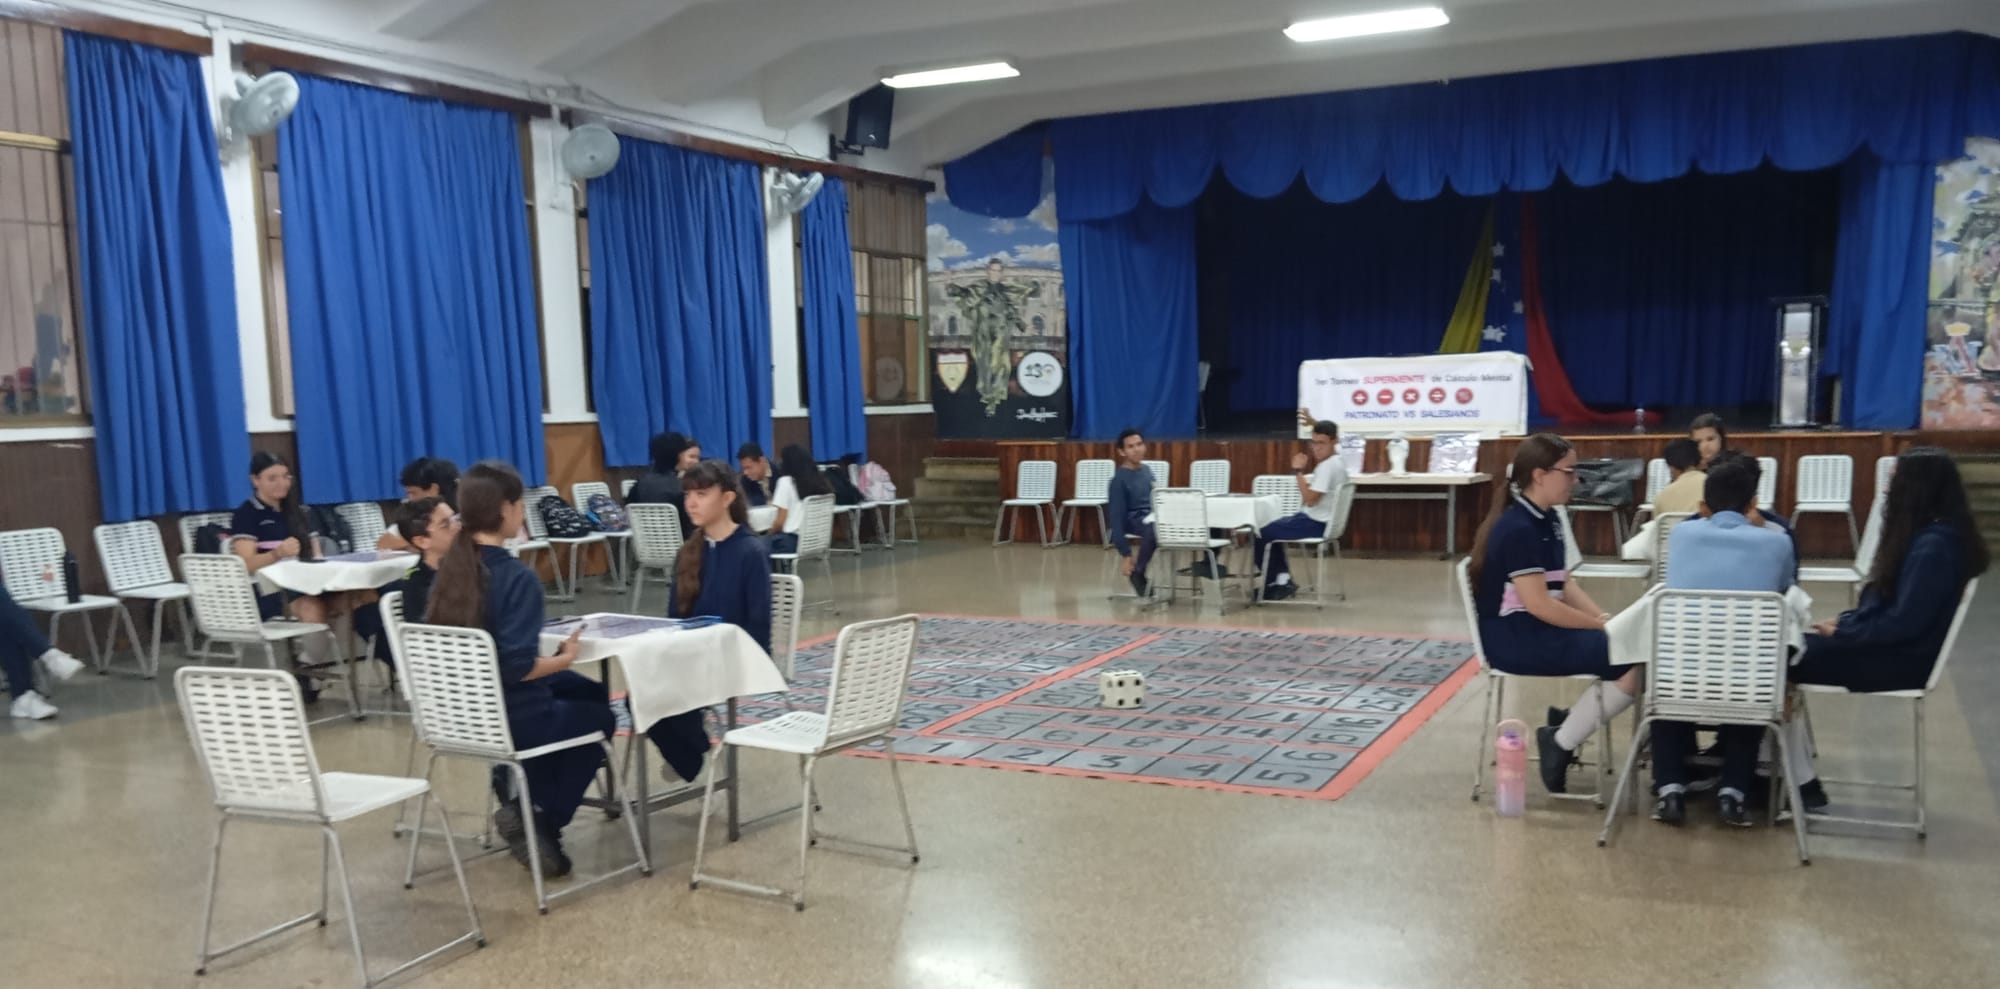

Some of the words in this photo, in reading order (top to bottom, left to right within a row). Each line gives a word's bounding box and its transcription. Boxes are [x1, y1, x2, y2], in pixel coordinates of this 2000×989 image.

[1330, 377, 1360, 385] Torneo
[1363, 374, 1425, 384] SUPERMENTE
[1481, 373, 1512, 382] Mental
[1344, 410, 1399, 418] PATRONATO
[1403, 410, 1416, 418] VS
[1420, 409, 1480, 418] SALESIANOS
[1140, 718, 1200, 731] 13
[1328, 716, 1385, 729] 16
[1219, 725, 1275, 738] 14
[1122, 735, 1164, 748] 8
[1306, 732, 1359, 746] 15
[927, 741, 954, 753] 1
[1003, 746, 1043, 761] 2
[1088, 754, 1128, 769] 3
[1184, 762, 1224, 777] 4
[1254, 768, 1312, 785] 5
